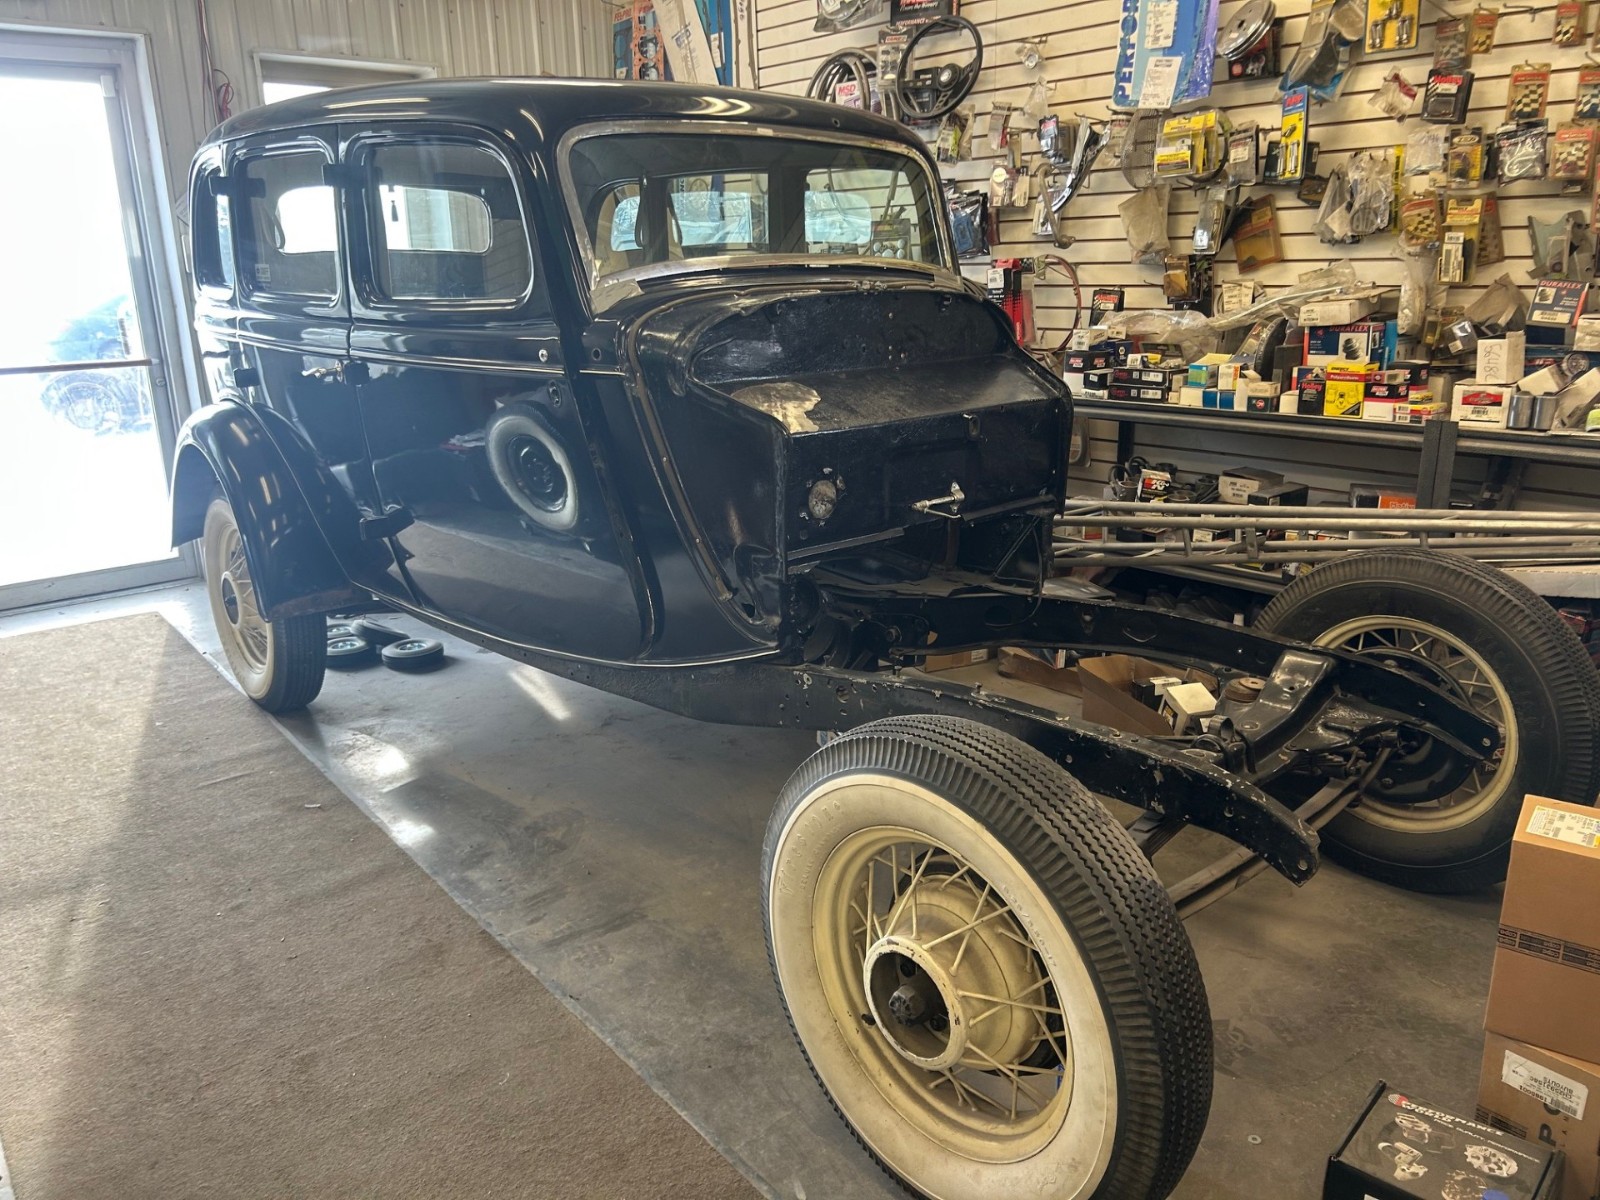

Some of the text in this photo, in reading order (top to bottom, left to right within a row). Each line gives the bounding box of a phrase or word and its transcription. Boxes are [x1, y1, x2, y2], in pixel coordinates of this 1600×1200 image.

[838, 84, 856, 97] MSD
[1540, 280, 1583, 289] DURAFLEX
[1301, 382, 1323, 392] Holley
